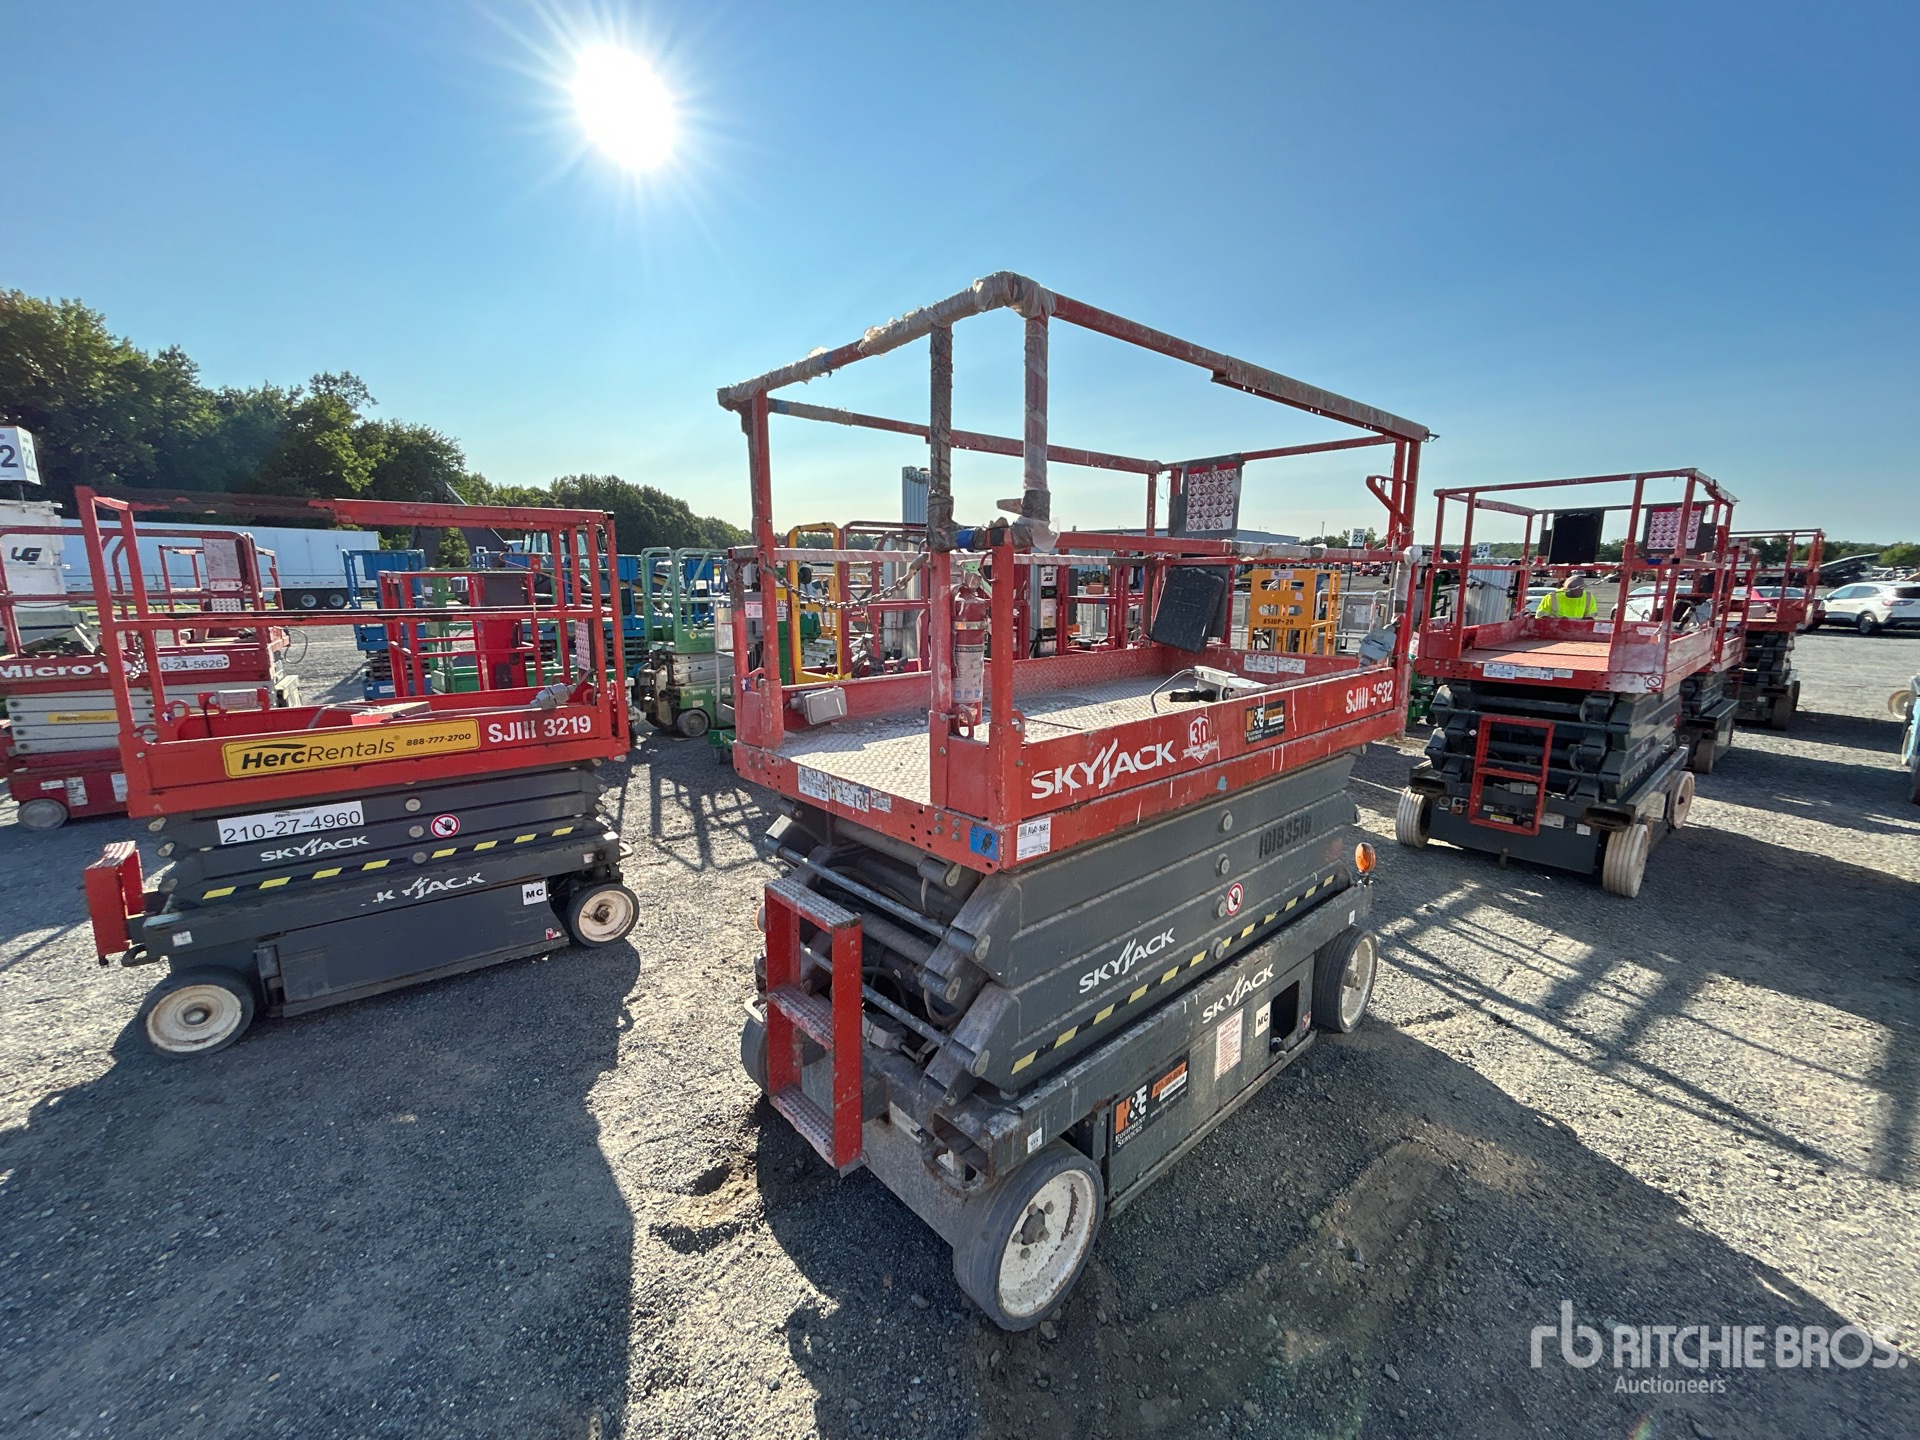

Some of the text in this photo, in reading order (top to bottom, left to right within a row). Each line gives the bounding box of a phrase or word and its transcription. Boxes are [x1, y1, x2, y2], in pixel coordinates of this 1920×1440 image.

[1353, 534, 1364, 542] 23
[543, 715, 592, 737] 3219
[1191, 720, 1208, 745] 30
[242, 733, 471, 770] HercRentals 888-777-2700
[1031, 738, 1176, 799] SKYJACK
[223, 811, 361, 843] 210-27-4960
[260, 835, 369, 862] SKYJACK
[525, 888, 544, 899] MC
[1079, 927, 1175, 993] SKYJACK
[1202, 963, 1274, 1023] SKYJACK
[1257, 1013, 1269, 1028] MC
